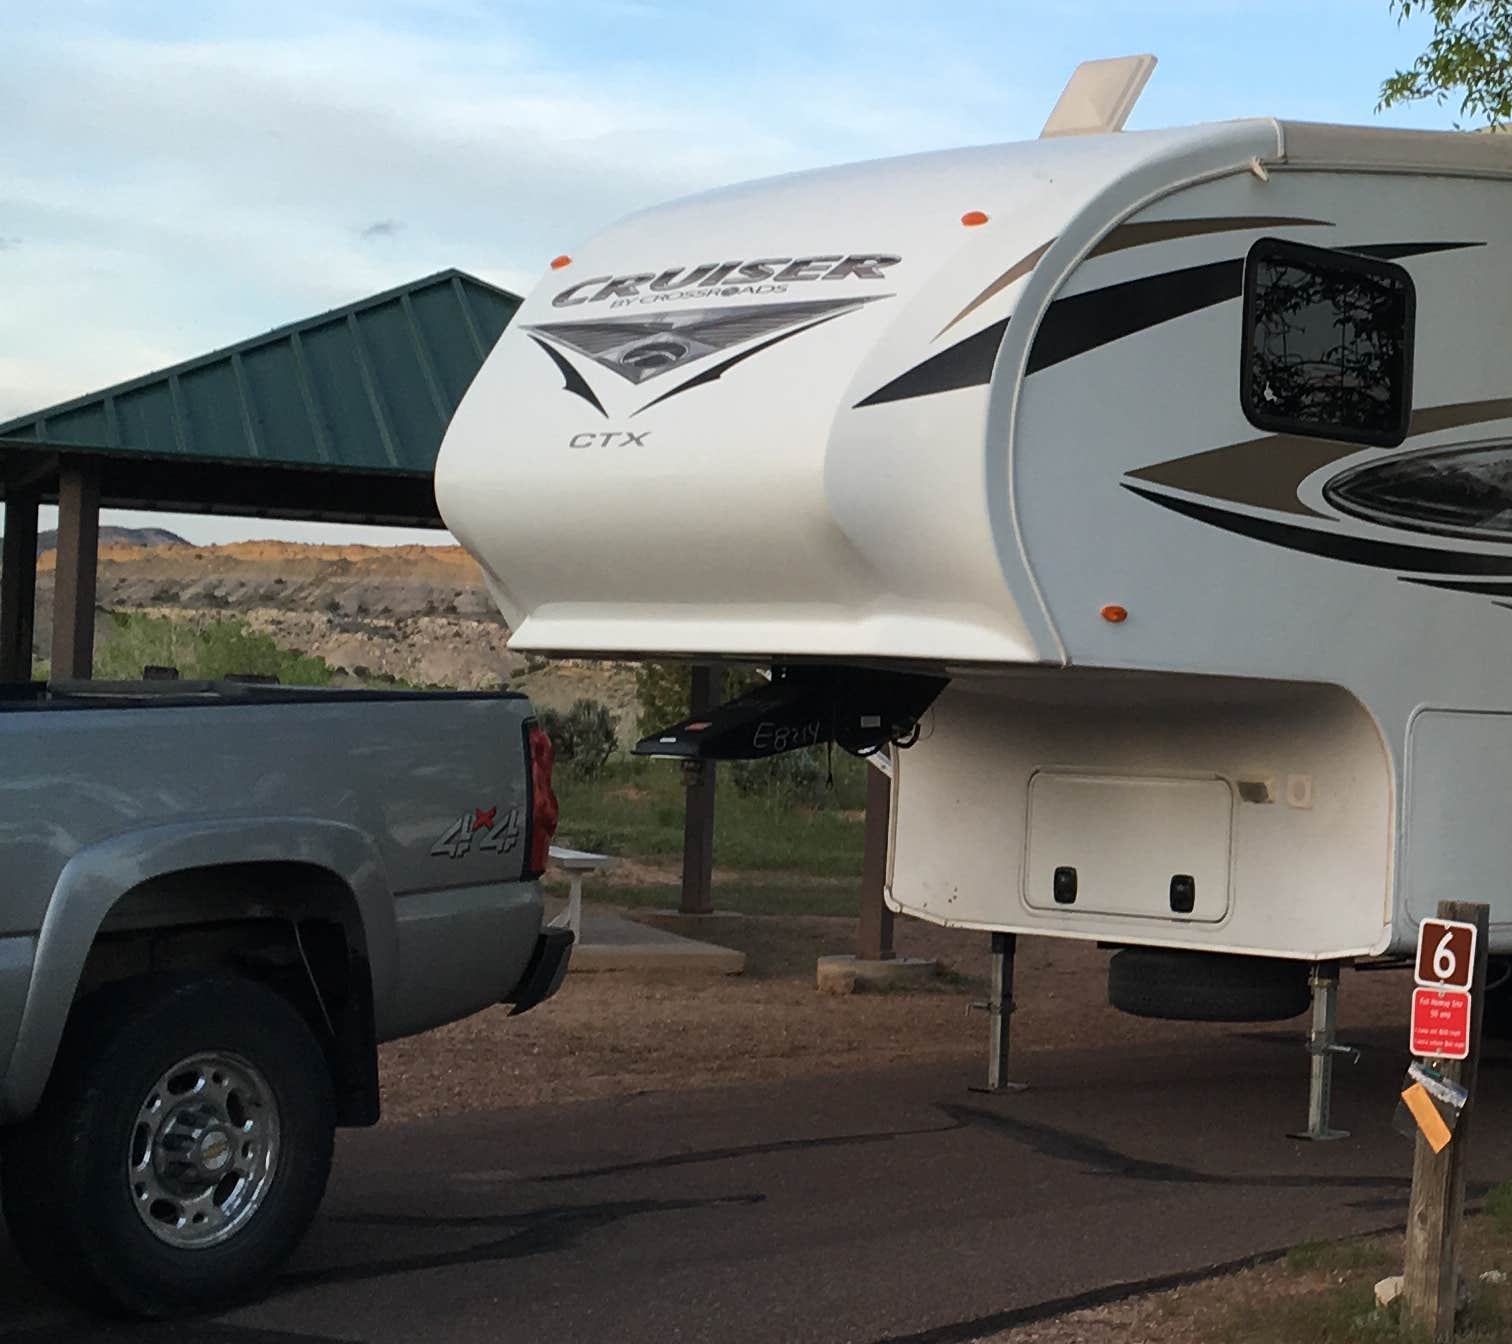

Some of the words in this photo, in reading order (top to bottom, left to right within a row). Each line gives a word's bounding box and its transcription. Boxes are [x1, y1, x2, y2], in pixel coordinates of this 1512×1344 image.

[551, 254, 901, 308] CRUISER
[609, 297, 638, 310] BY
[639, 283, 789, 306] CROSSROADS
[568, 431, 651, 449] CTX
[1433, 931, 1456, 979] 6
